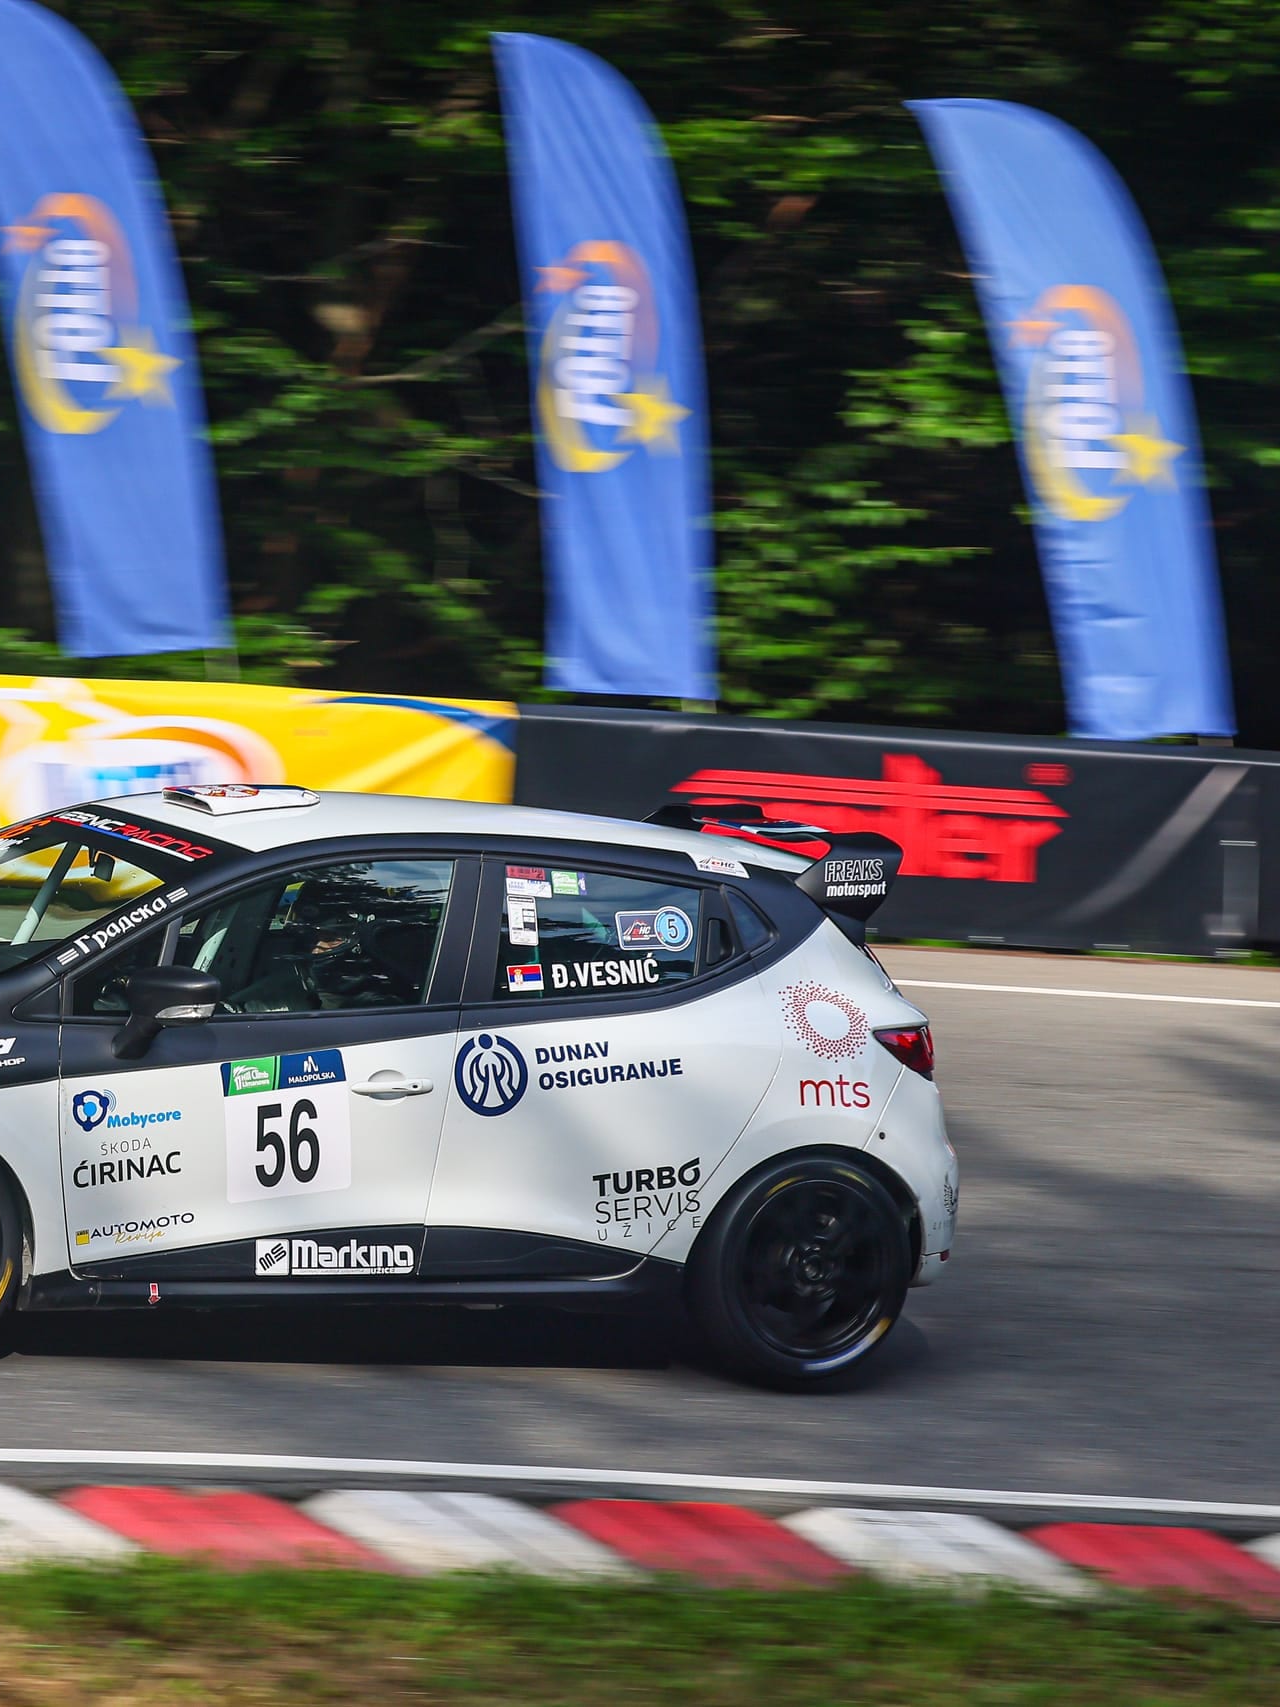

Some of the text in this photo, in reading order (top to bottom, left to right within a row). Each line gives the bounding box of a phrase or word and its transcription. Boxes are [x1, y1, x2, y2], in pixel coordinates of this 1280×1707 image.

[824, 858, 884, 883] FREAKS
[826, 881, 887, 898] motorsport
[73, 896, 168, 955] Градска
[667, 918, 677, 939] 5
[551, 952, 660, 989] Đ.VESNIĆ
[535, 1041, 610, 1065] DUNAV
[288, 1071, 336, 1084] MAŁOPOLSKA
[538, 1058, 683, 1091] OSIGURANJE
[799, 1074, 871, 1109] mts
[107, 1110, 182, 1128] Mobycore
[100, 1137, 152, 1156] ŠKODA
[255, 1098, 321, 1188] 56
[73, 1151, 182, 1189] ĆIRINAC
[595, 1189, 701, 1225] SERVIS
[90, 1212, 195, 1239] AUTOMOTO
[597, 1215, 702, 1242] UŽICE
